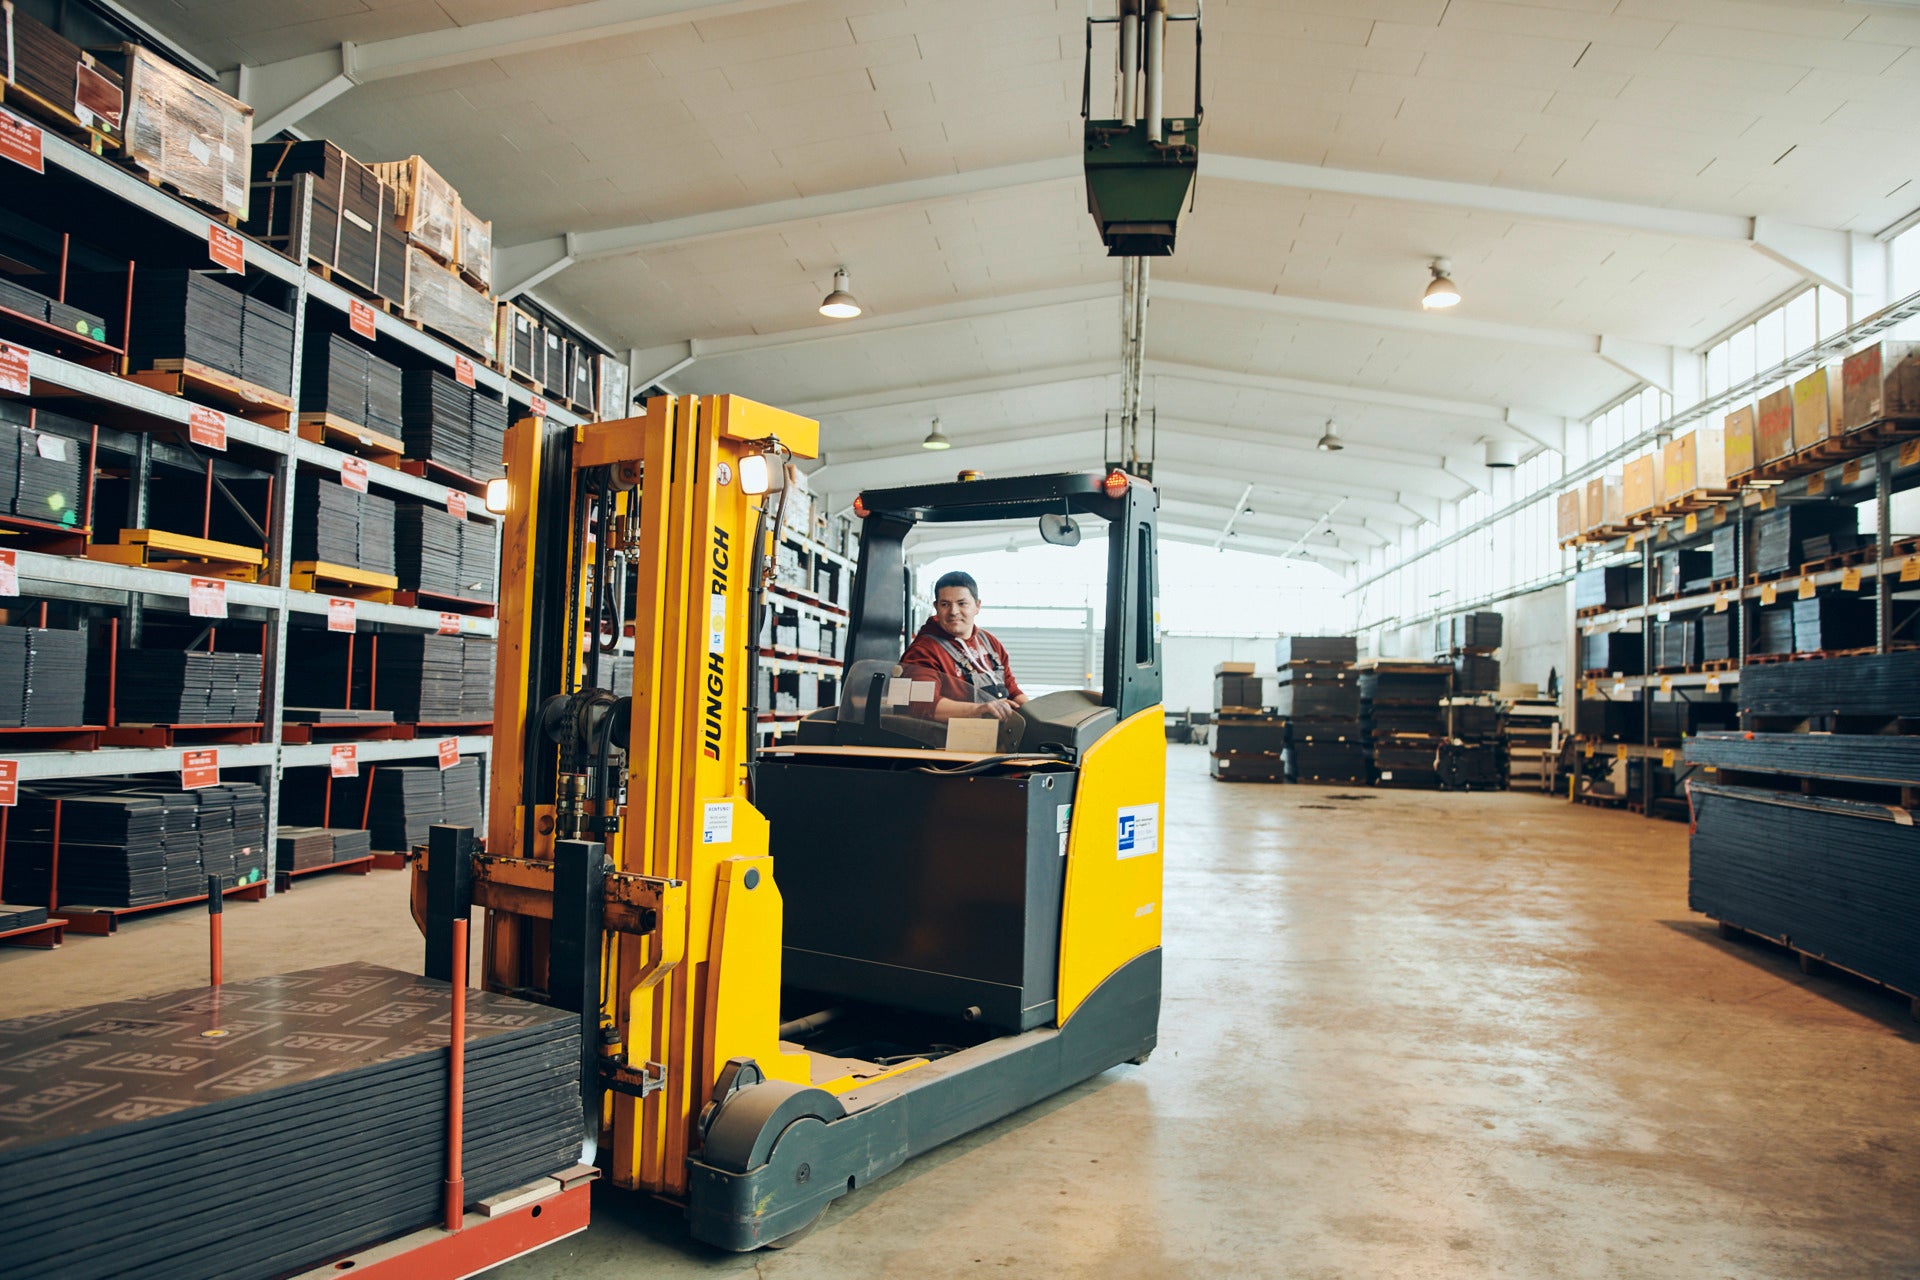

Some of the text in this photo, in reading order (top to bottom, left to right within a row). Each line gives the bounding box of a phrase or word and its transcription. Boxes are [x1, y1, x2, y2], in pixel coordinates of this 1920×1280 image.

[265, 1000, 351, 1013] PERI
[357, 1006, 431, 1027] PERI
[268, 1035, 366, 1051] PERI
[110, 1053, 215, 1070] PERI
[211, 1061, 306, 1091] PERI
